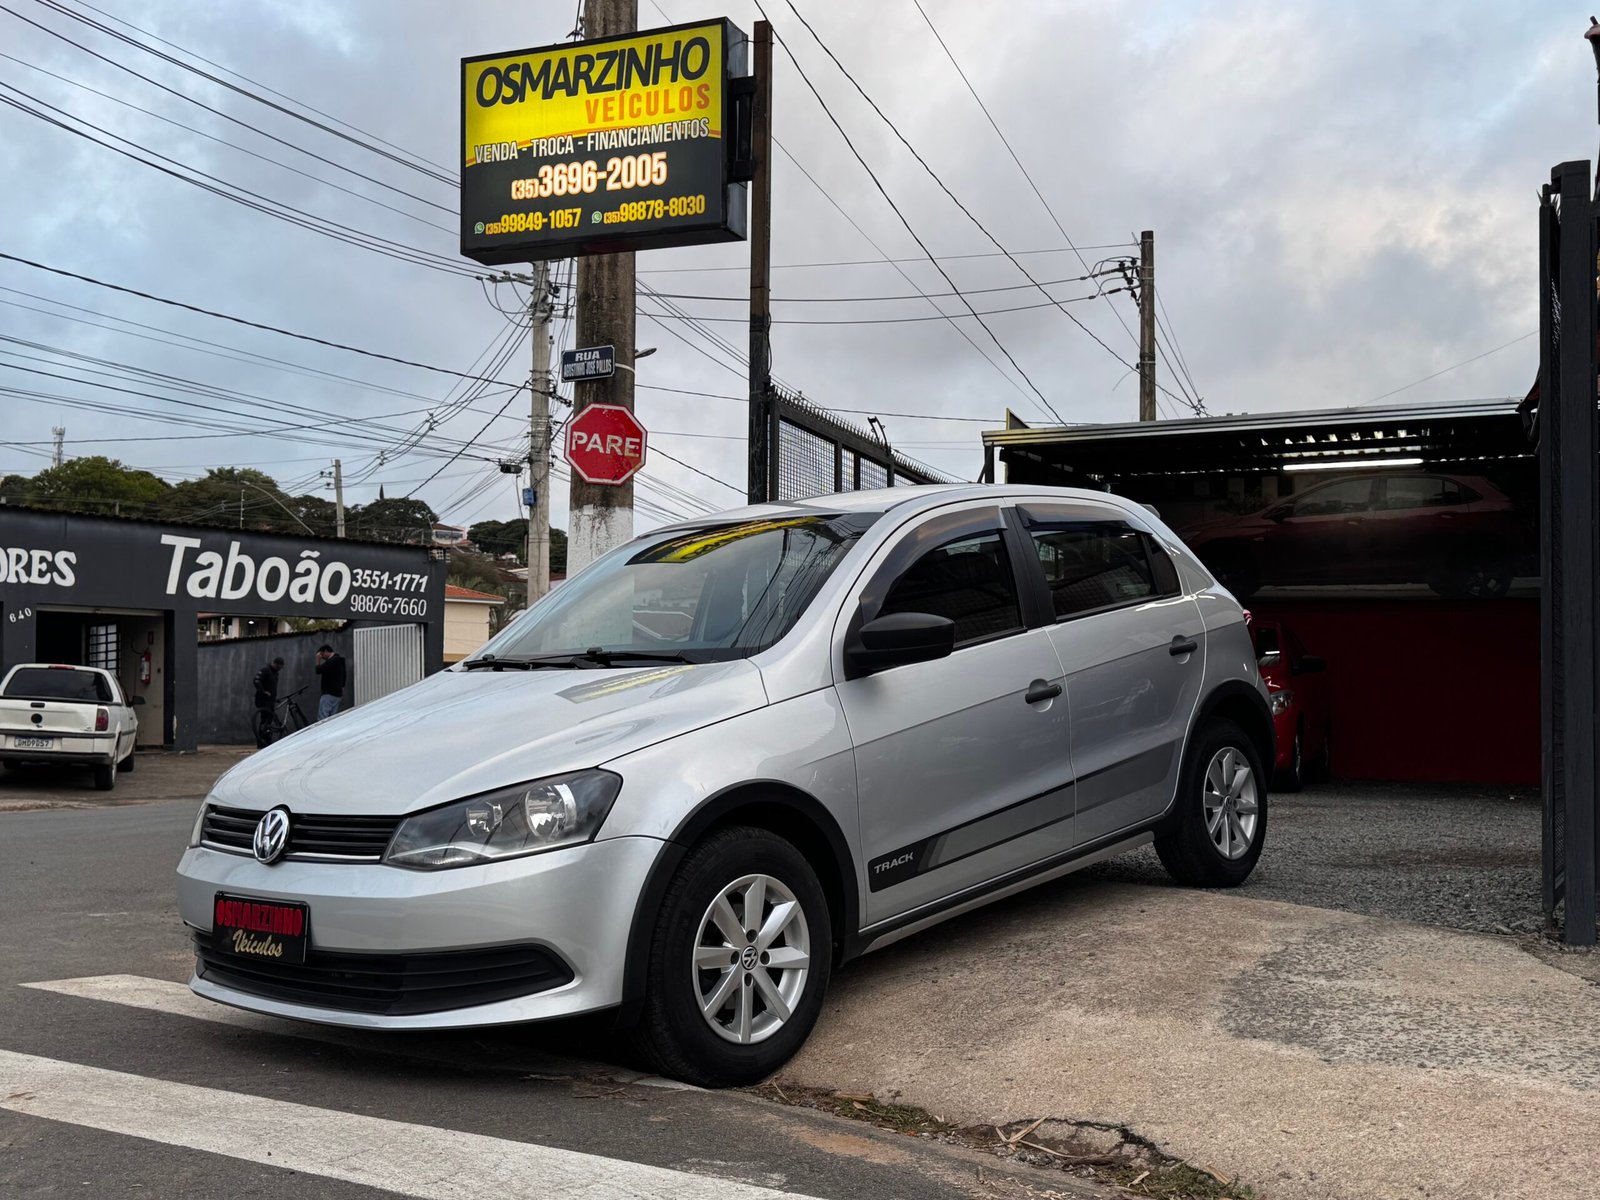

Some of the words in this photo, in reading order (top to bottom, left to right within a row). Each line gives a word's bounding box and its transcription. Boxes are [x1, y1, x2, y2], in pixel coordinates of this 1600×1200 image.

[476, 37, 710, 107] OSMARZINHO
[585, 83, 711, 124] VEÍCULOS
[475, 141, 518, 164] VENDA
[530, 134, 574, 158] TROCA
[587, 117, 709, 152] FINANCIAMENTOS
[575, 351, 600, 362] RUA
[571, 431, 641, 458] PARE
[161, 534, 351, 605] Taboão
[9, 607, 32, 623] 640
[873, 852, 914, 874] TRACK
[215, 899, 303, 937] OSMARZINHO
